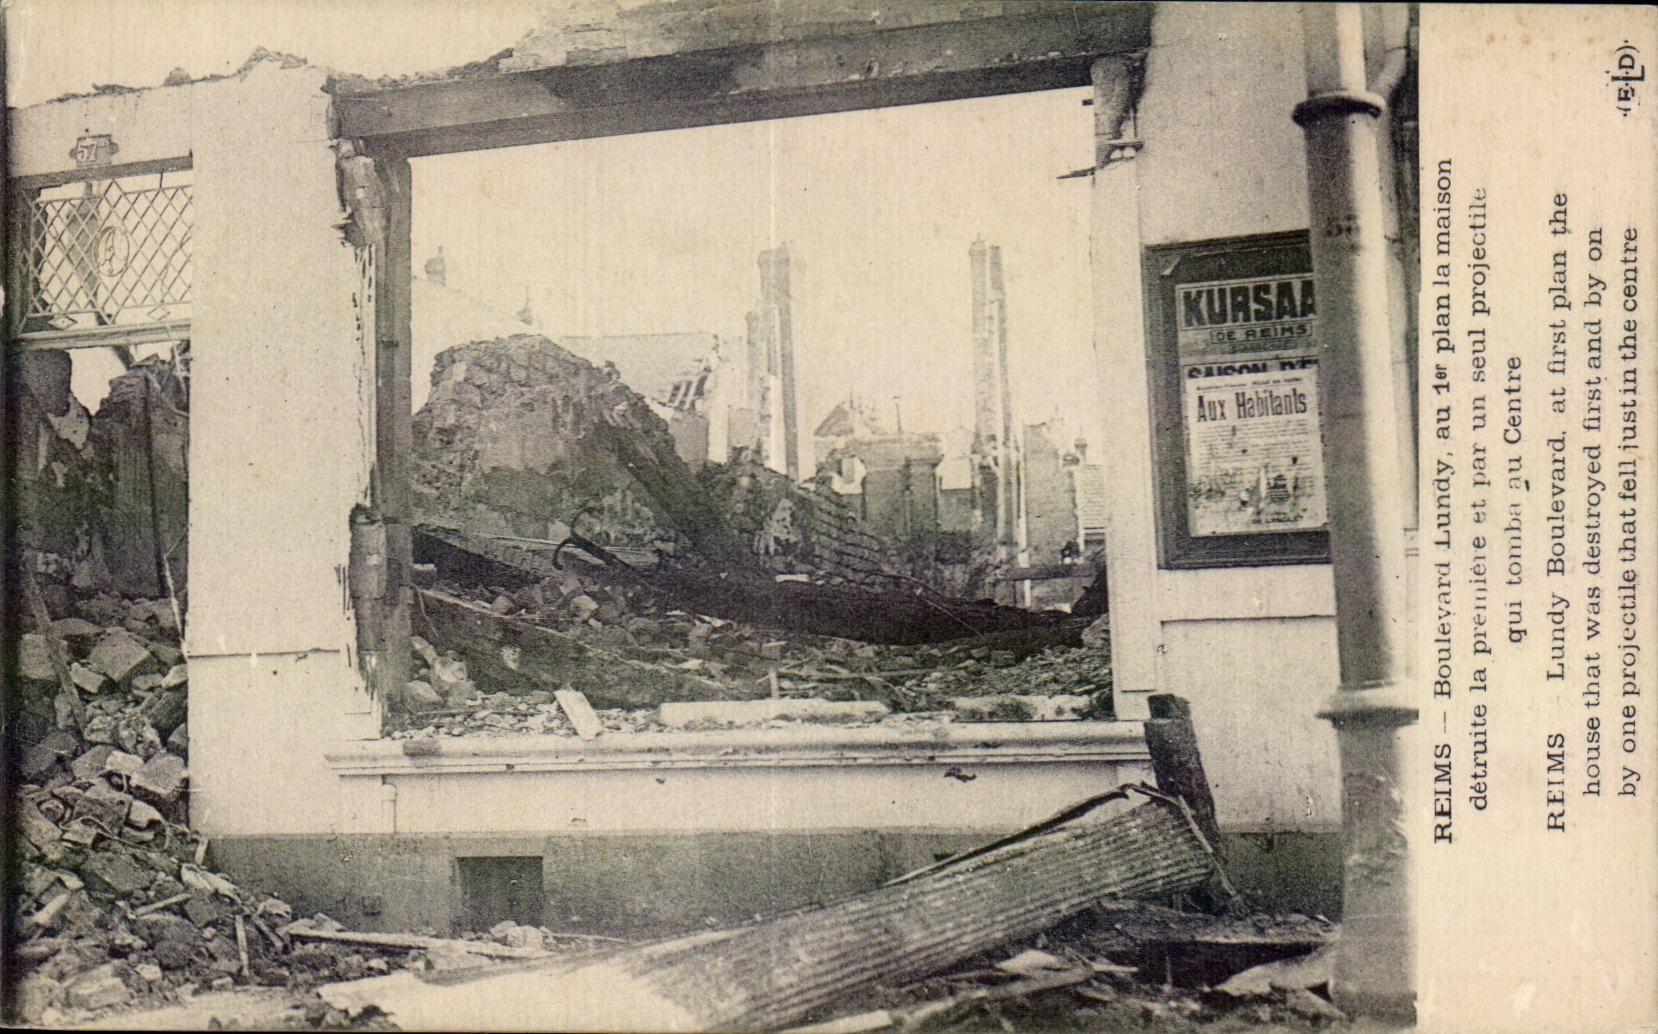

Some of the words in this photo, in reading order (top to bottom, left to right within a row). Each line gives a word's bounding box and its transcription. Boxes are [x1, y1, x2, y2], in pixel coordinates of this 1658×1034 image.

[1215, 331, 1237, 342] DE
[1245, 324, 1308, 338] REIMS
[1196, 395, 1227, 423] Aux
[1235, 387, 1307, 420] Habitants
